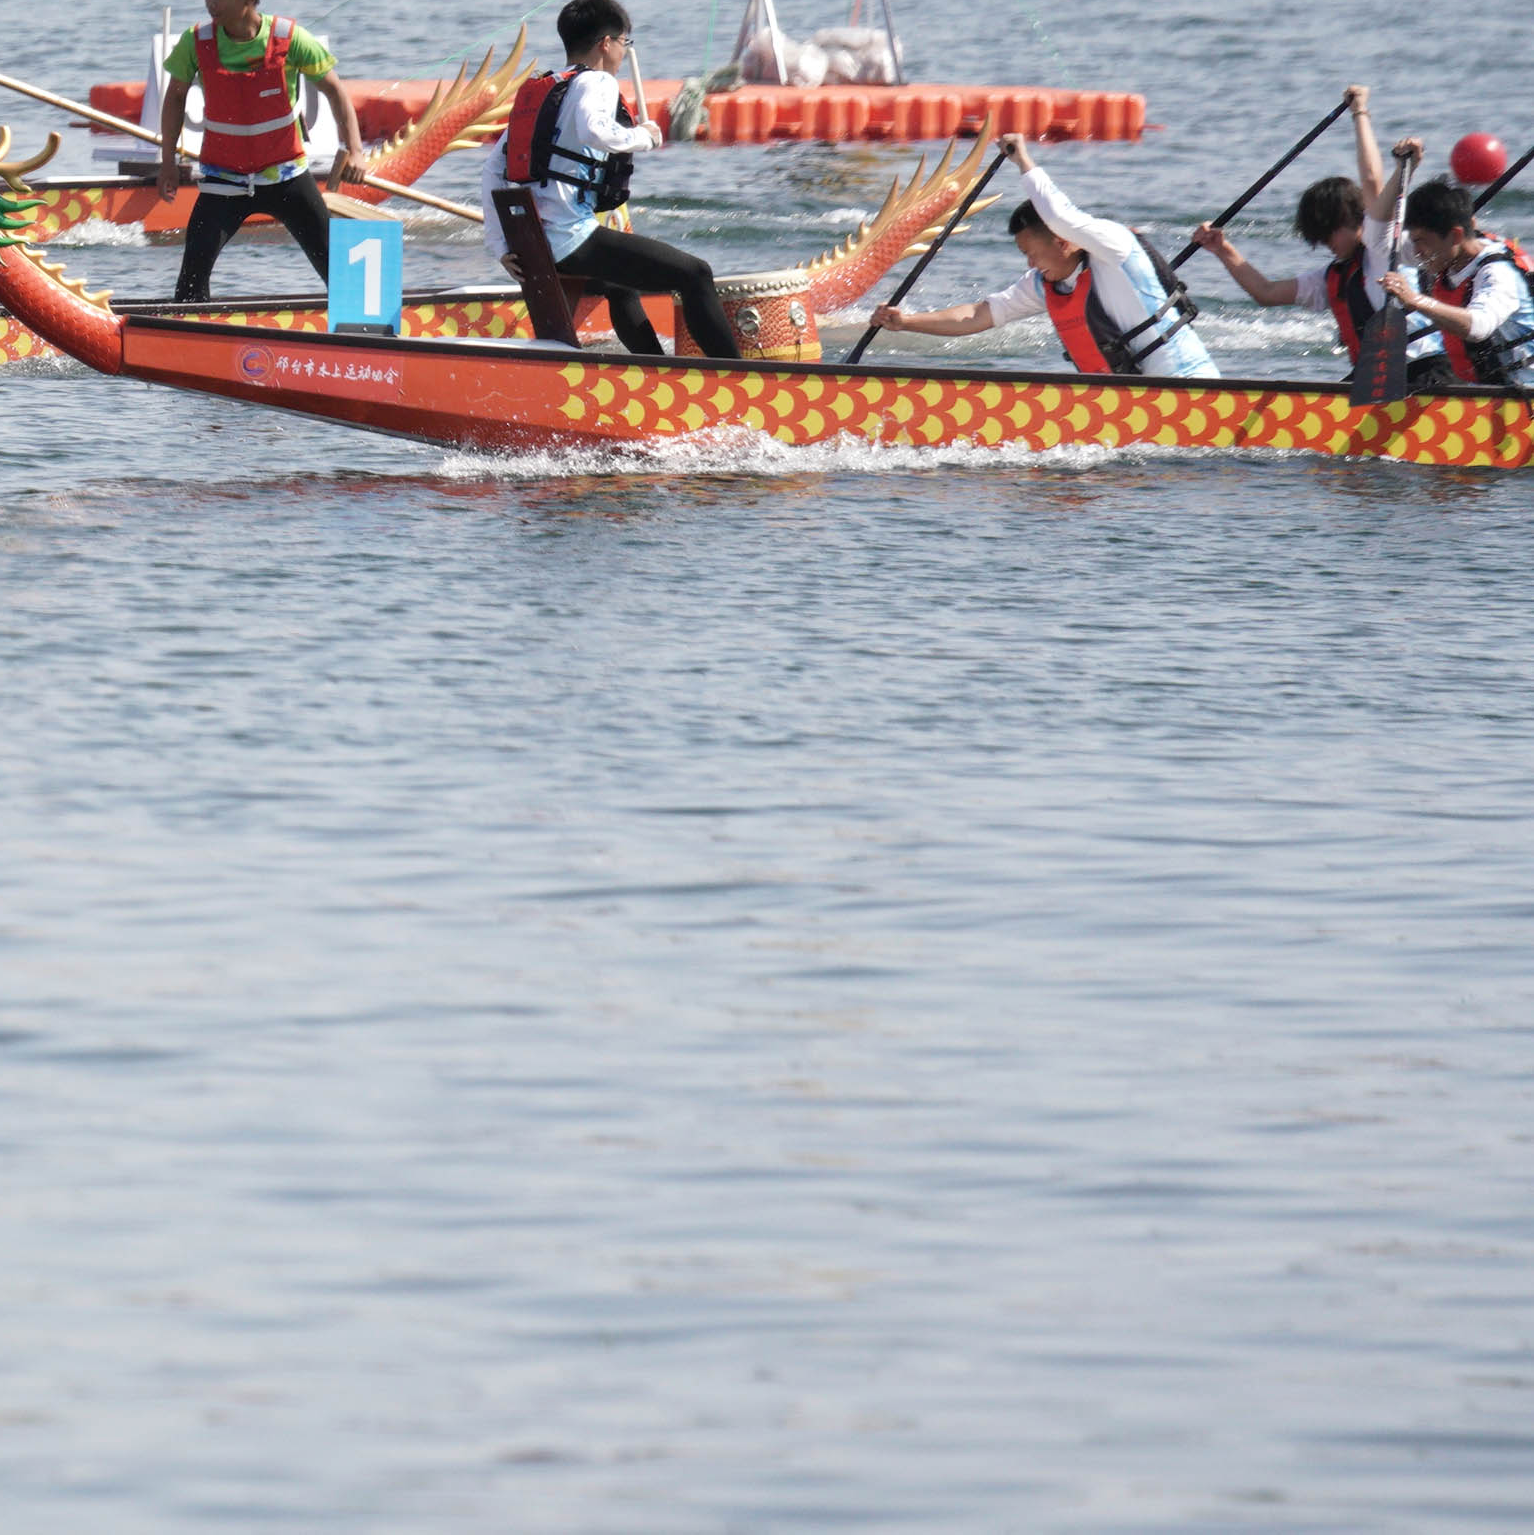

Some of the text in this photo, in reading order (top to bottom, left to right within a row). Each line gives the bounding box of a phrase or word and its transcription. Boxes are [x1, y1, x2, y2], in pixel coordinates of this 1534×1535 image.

[349, 239, 381, 316] 1
[275, 356, 398, 384] 邢台市水上运动协会
